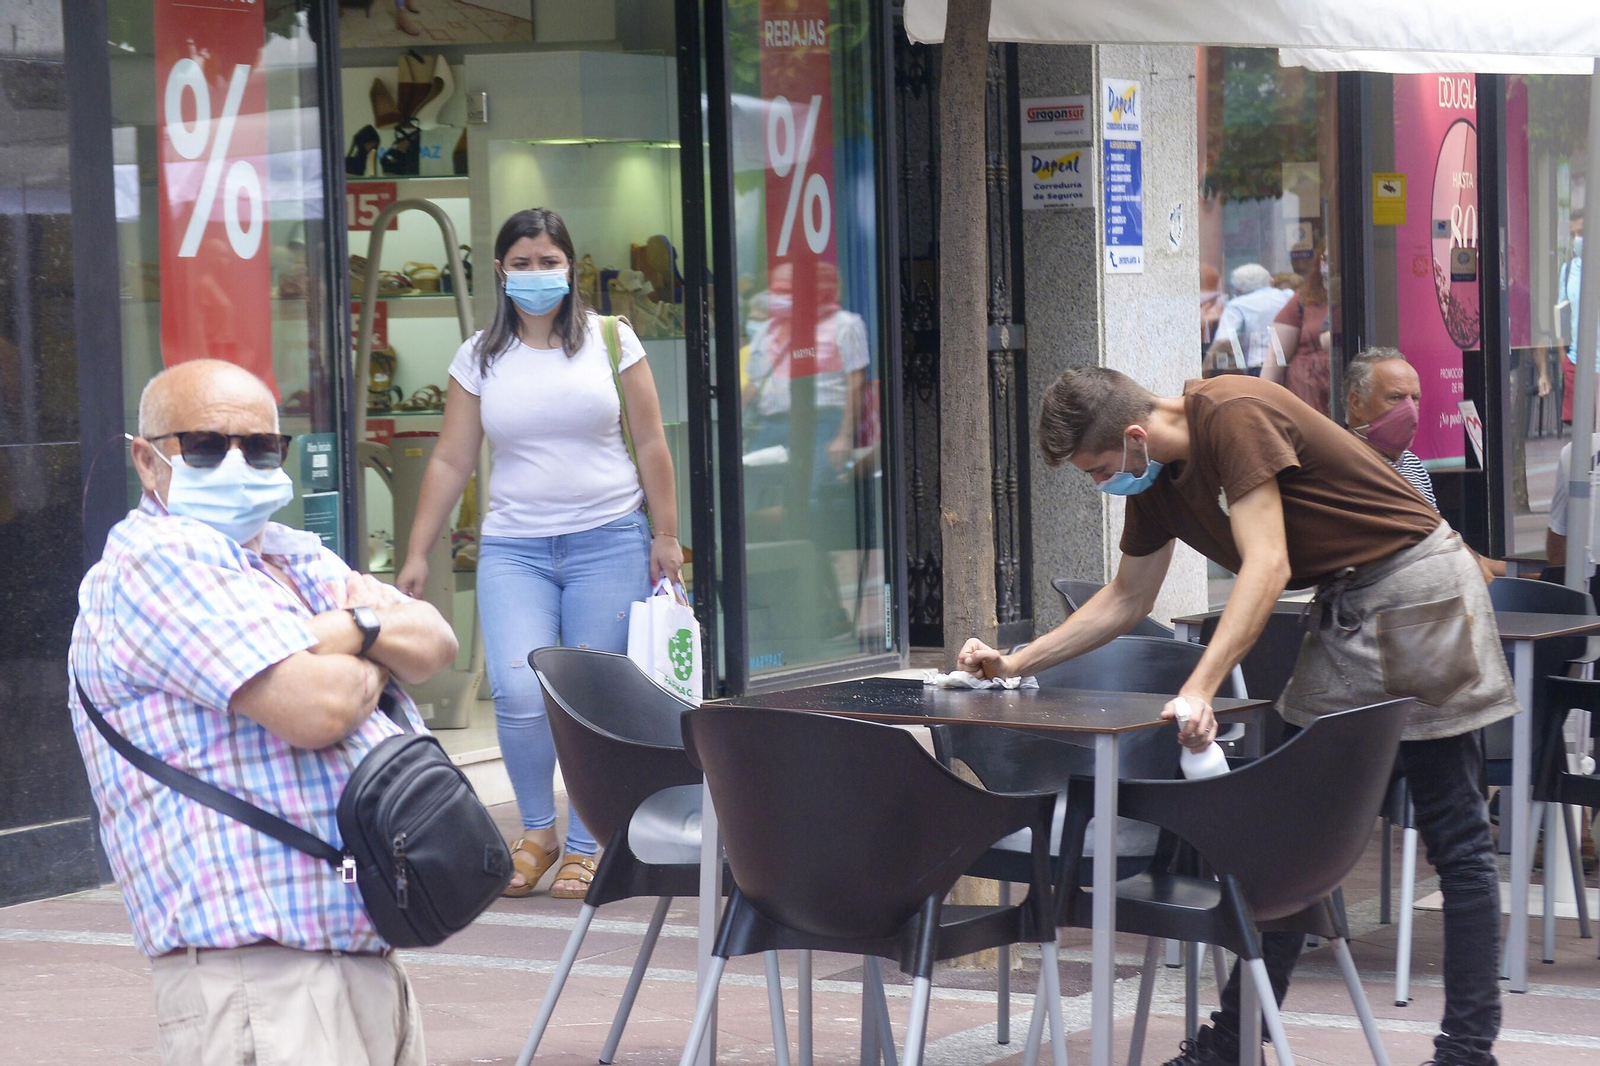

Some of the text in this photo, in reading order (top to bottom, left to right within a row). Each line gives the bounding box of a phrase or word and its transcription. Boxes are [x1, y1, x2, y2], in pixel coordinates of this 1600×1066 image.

[765, 18, 826, 47] REBAJAS
[1452, 171, 1474, 189] HASTA
[1047, 192, 1083, 201] Seguros
